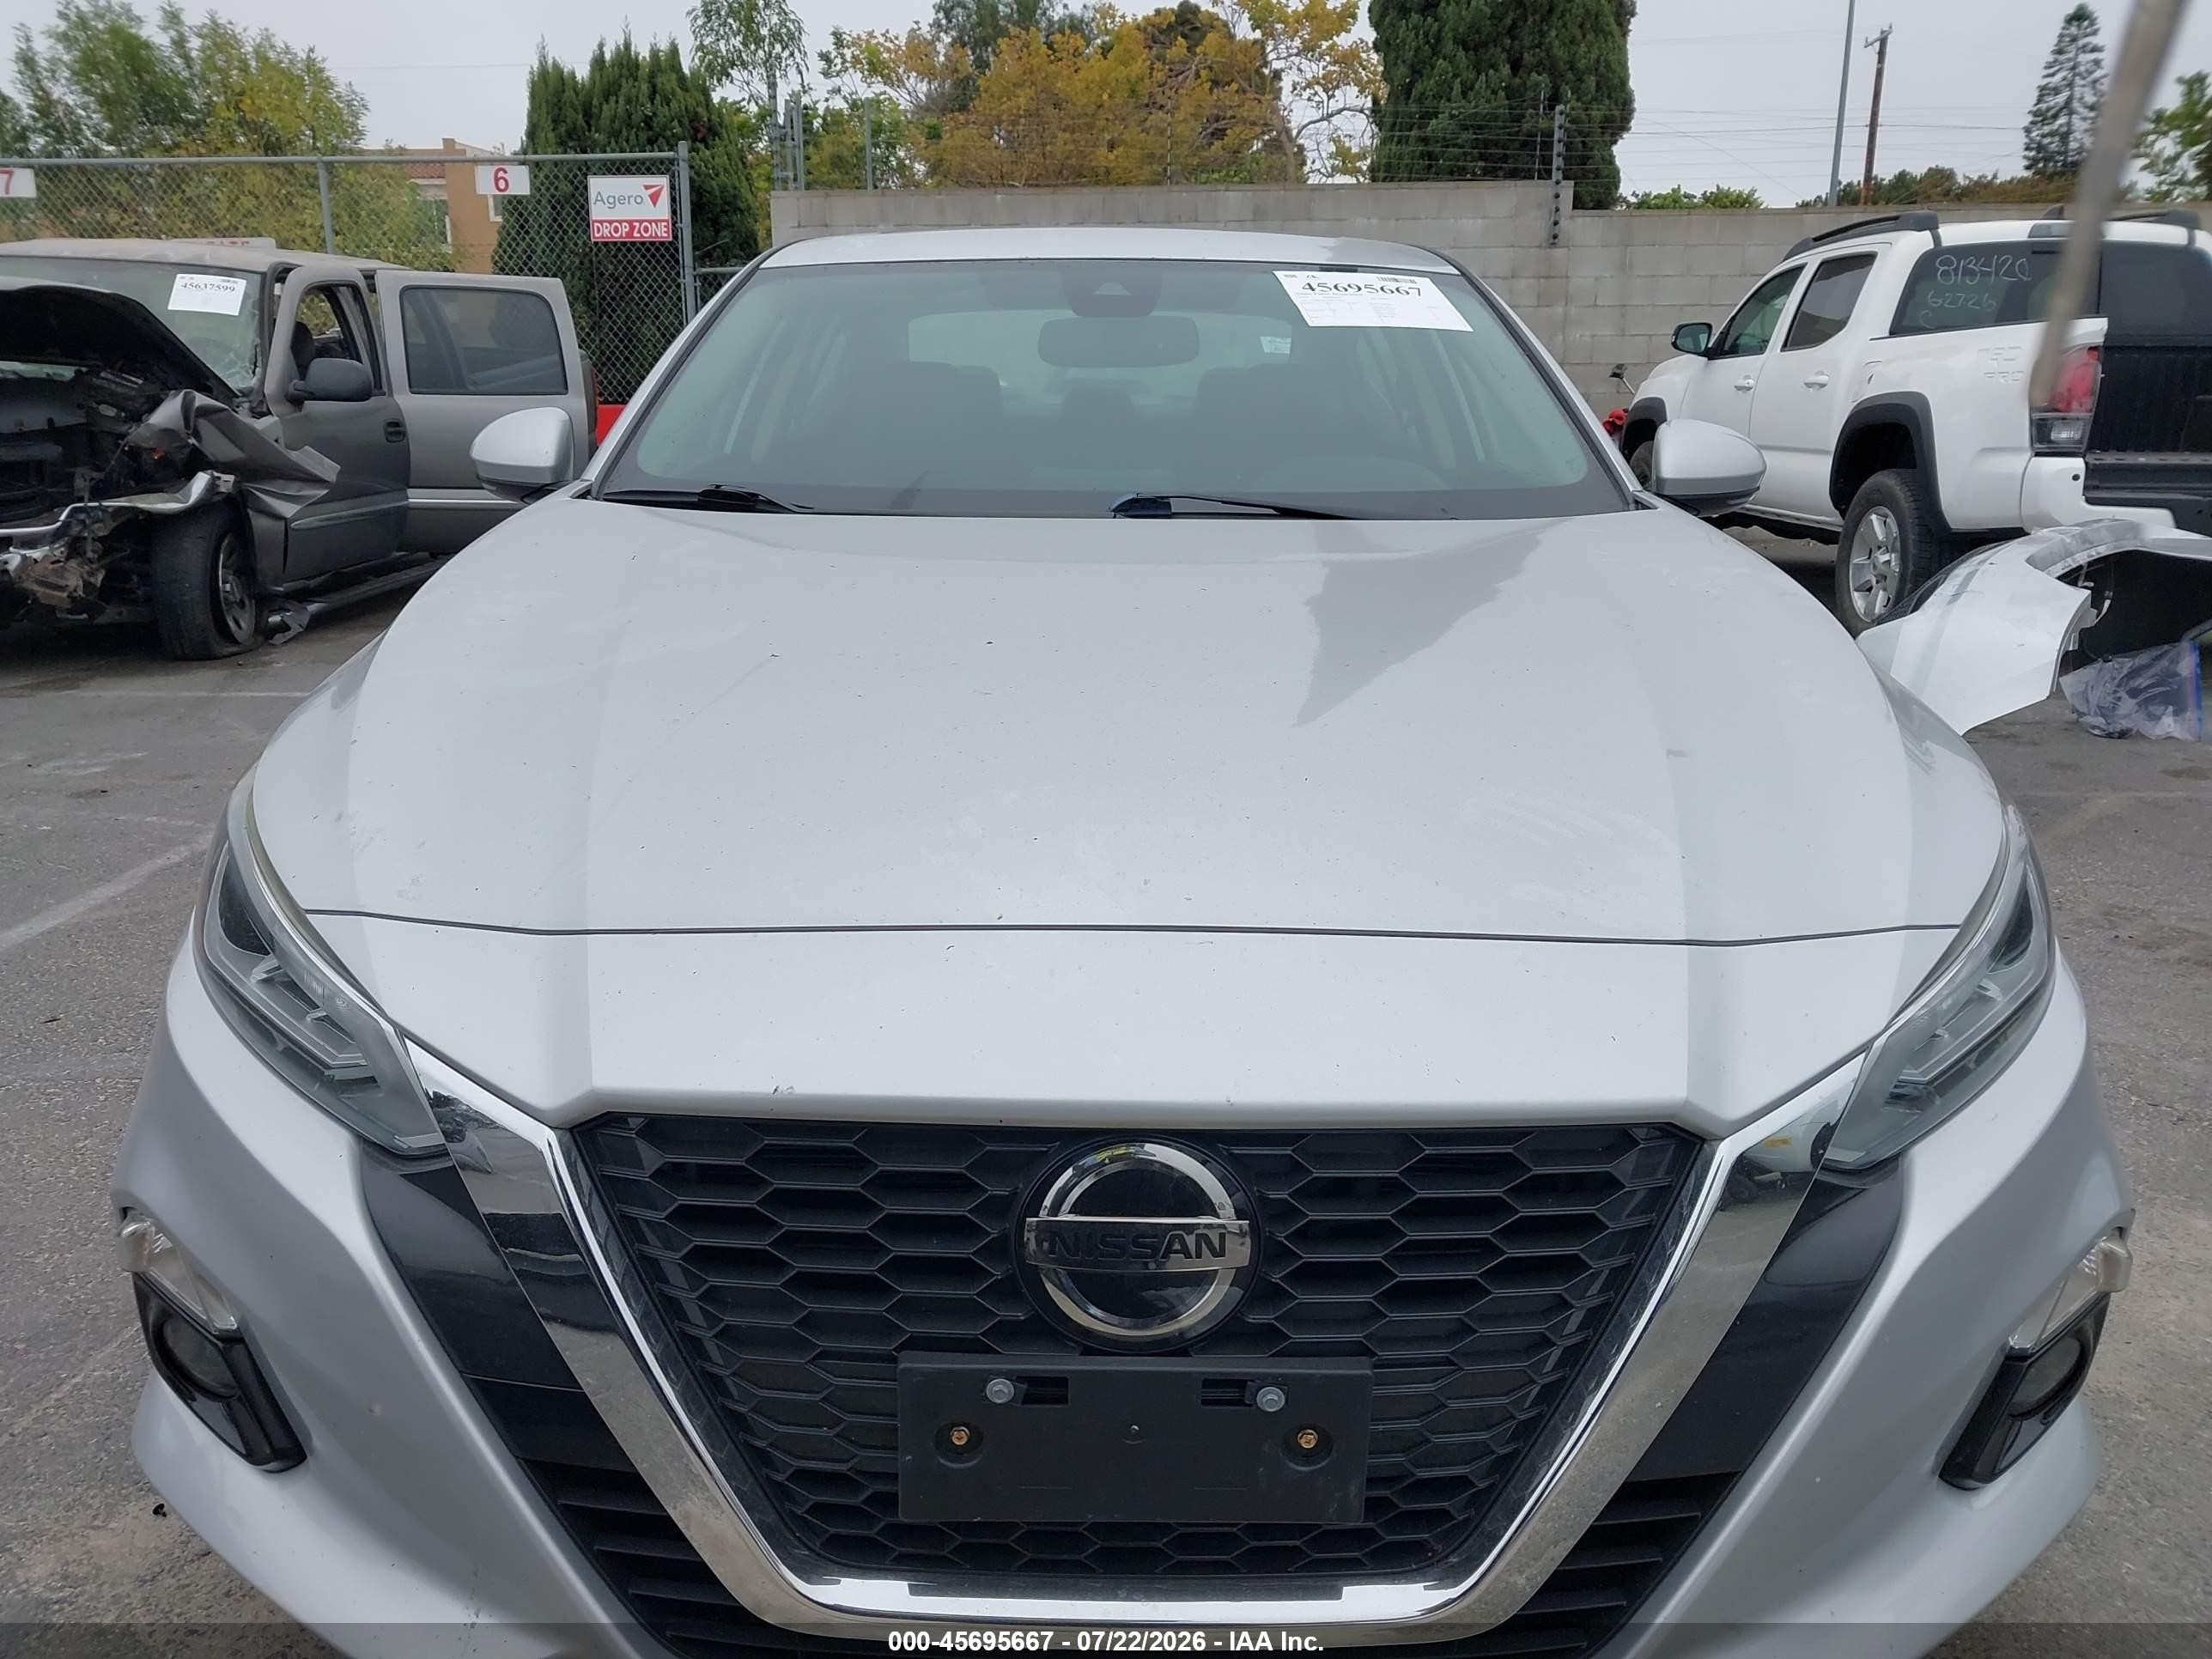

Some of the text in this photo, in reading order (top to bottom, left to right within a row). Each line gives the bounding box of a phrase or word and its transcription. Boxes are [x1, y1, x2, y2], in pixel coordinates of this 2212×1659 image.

[494, 167, 508, 192] 6
[593, 191, 644, 209] Agero
[594, 222, 668, 237] DROP ZONE
[180, 283, 235, 292] 45637599
[1302, 282, 1421, 296] 45695667
[1047, 1231, 1226, 1261] NISSAN
